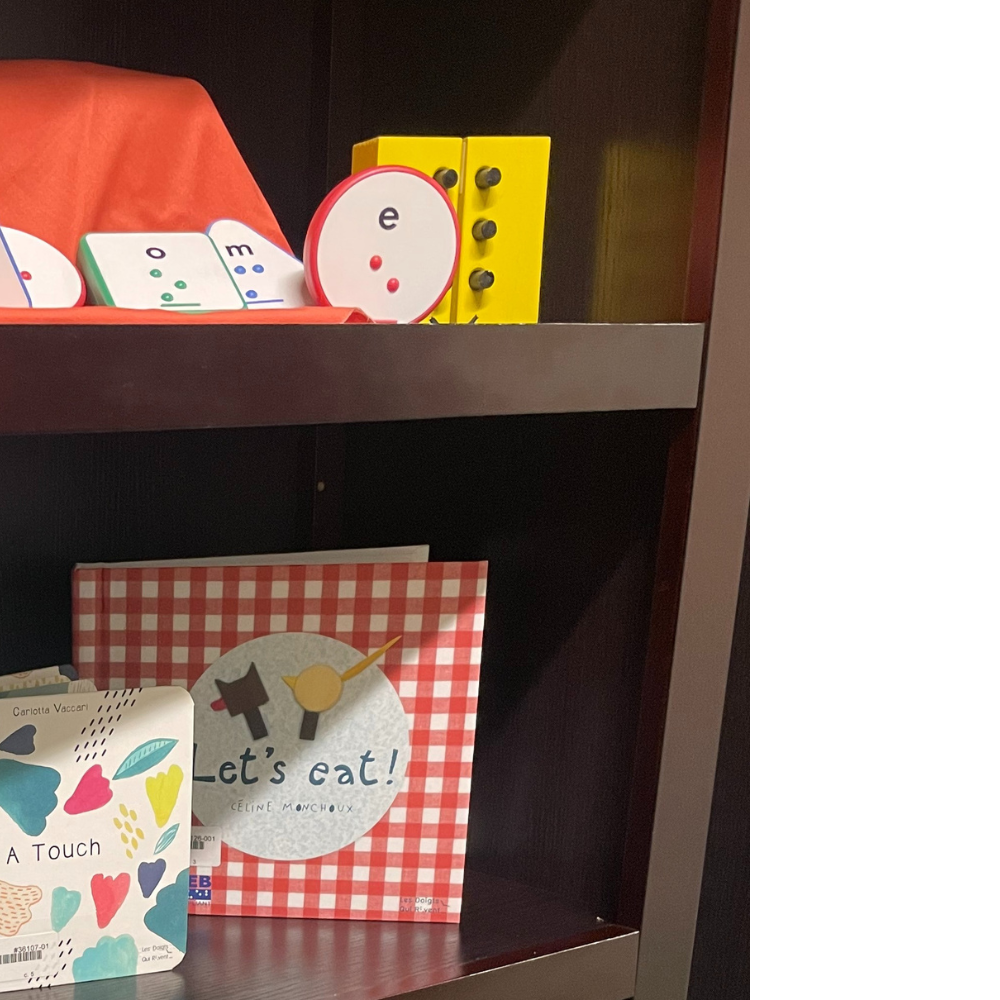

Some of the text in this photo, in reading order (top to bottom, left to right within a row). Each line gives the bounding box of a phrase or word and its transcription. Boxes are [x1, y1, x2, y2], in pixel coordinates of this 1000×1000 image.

[378, 206, 400, 230] e
[146, 246, 166, 259] o
[225, 241, 254, 257] m
[12, 703, 89, 717] Carlotta Vaccari
[192, 742, 399, 786] Let's eat!
[282, 803, 353, 813] MONCHOUX
[6, 838, 101, 864] A Touch
